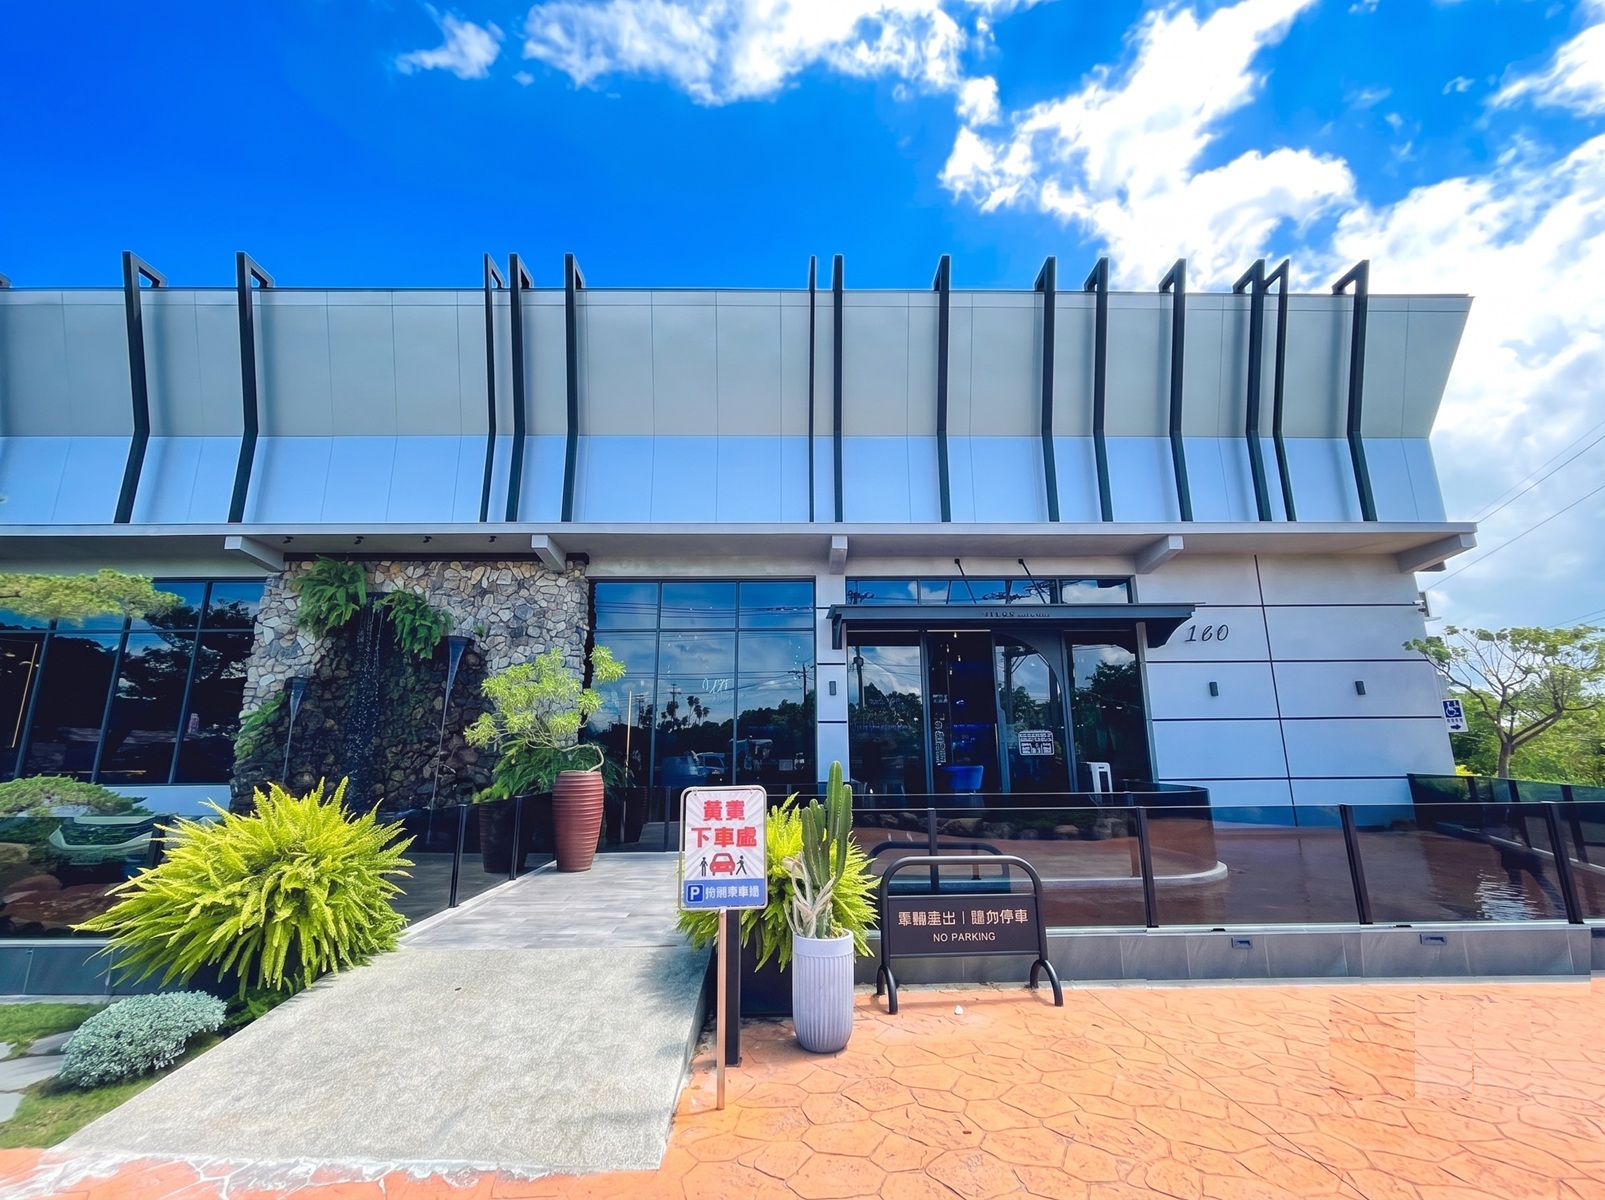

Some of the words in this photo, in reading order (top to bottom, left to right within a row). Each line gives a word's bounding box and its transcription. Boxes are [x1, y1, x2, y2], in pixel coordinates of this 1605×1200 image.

[1184, 624, 1229, 642] 160
[691, 826, 757, 848] 下車處
[933, 933, 948, 942] NO
[951, 932, 996, 942] PARKING
